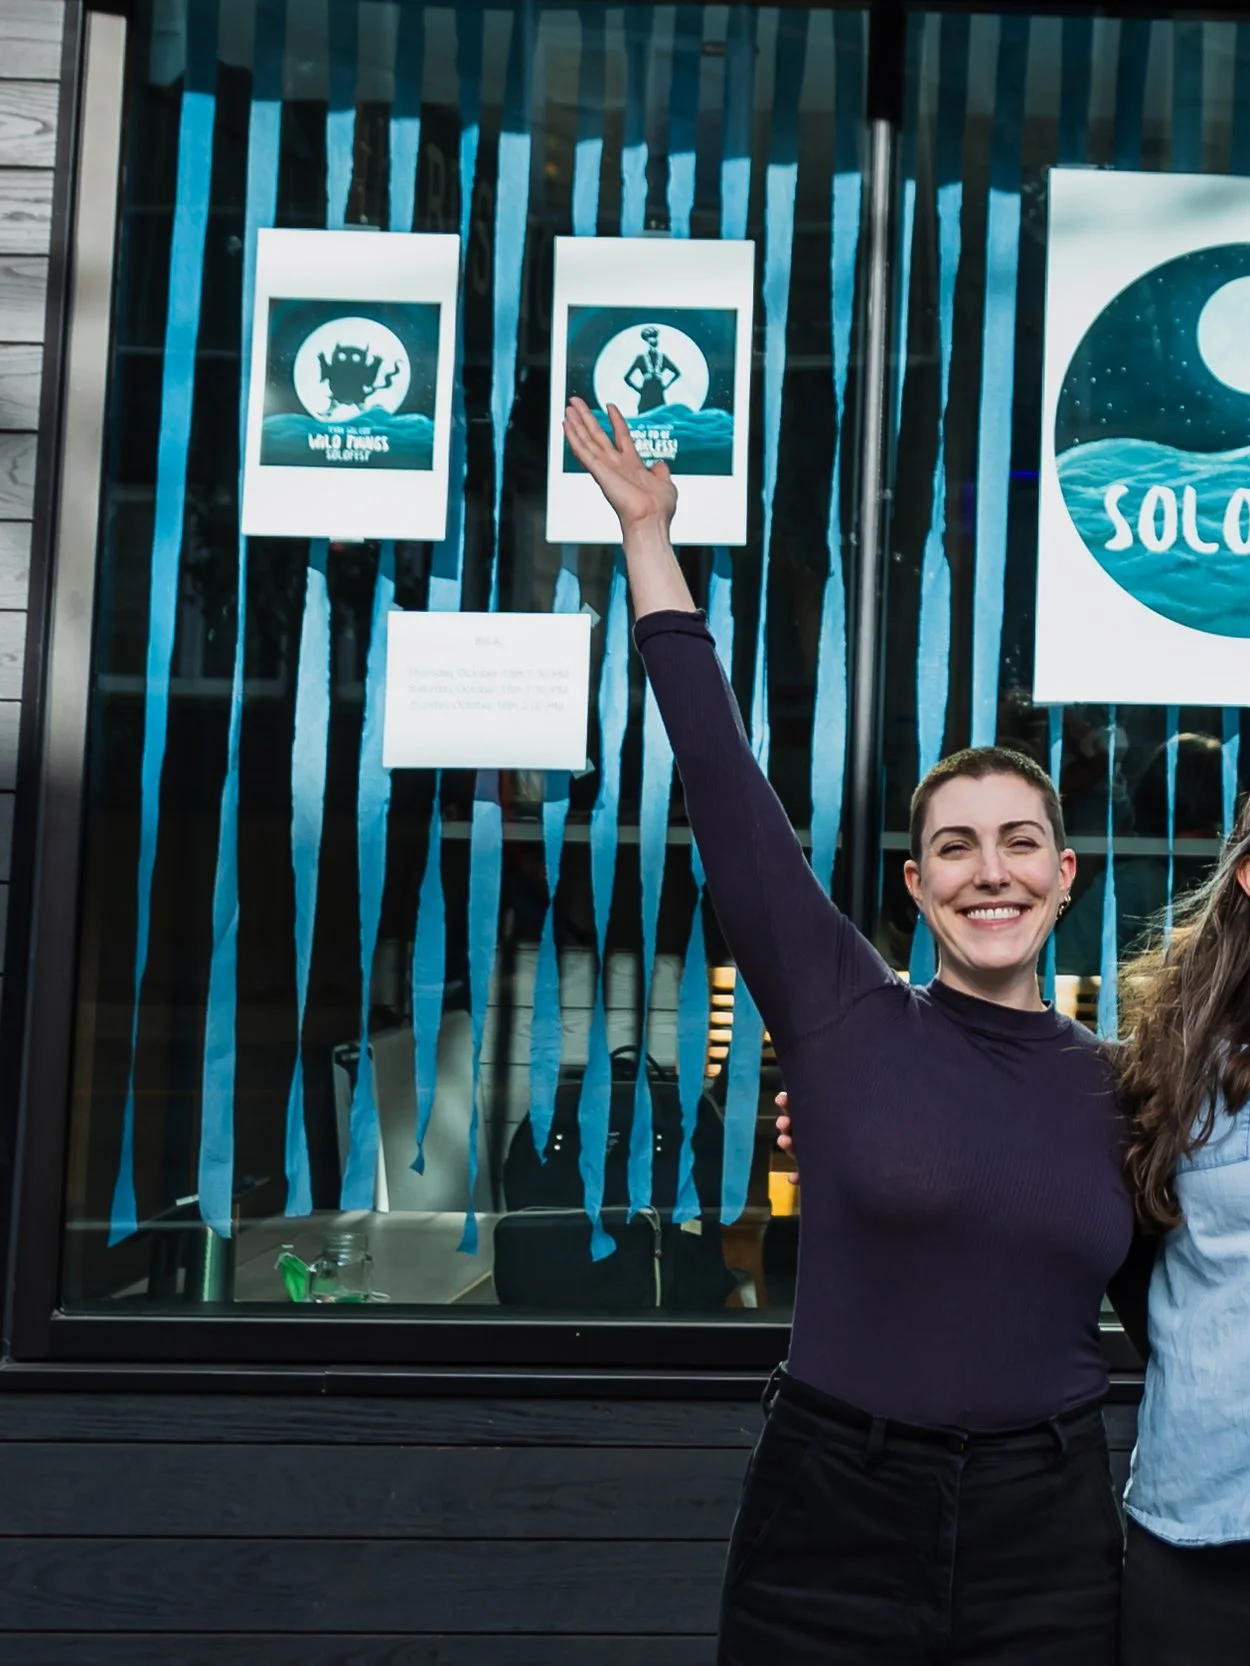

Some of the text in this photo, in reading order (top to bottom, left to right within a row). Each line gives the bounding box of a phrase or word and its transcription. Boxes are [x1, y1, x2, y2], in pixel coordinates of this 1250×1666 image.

[308, 433, 389, 452] WILD THINGS
[634, 438, 678, 453] ARLESS!
[326, 449, 371, 462] SOLOFEST
